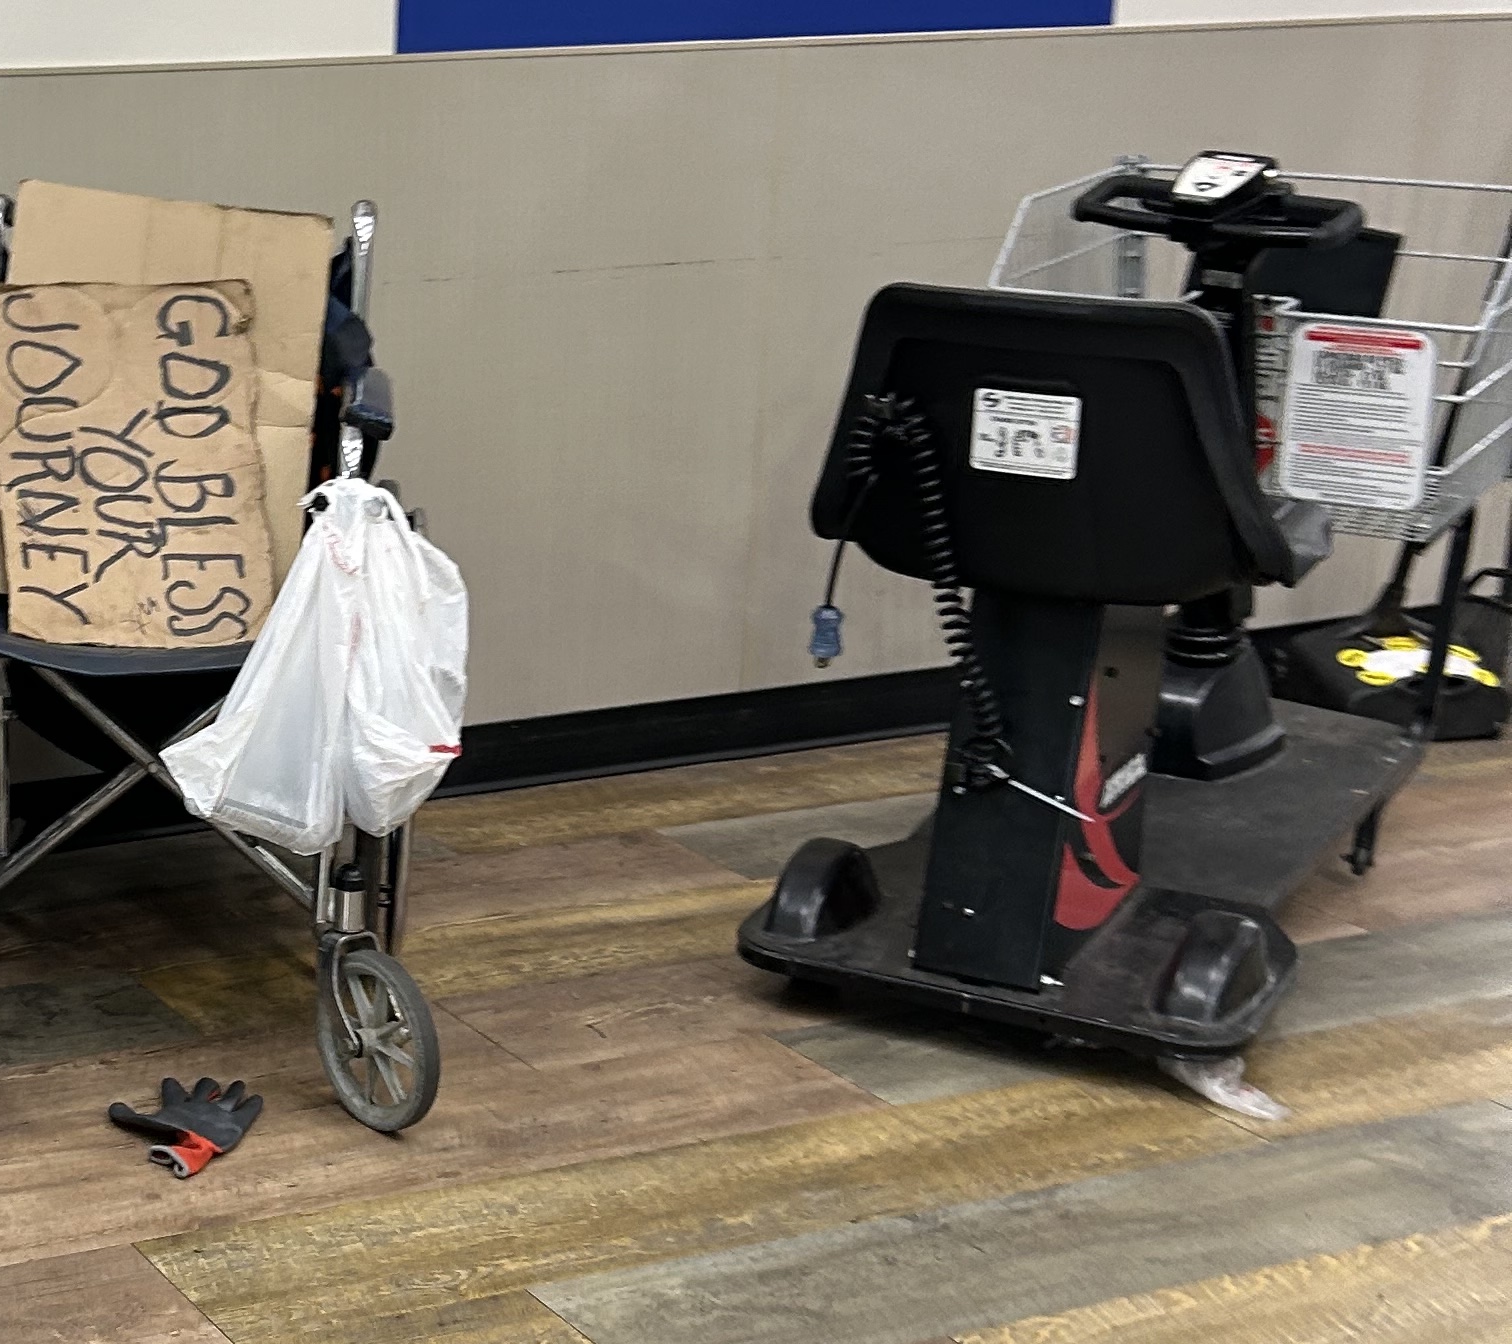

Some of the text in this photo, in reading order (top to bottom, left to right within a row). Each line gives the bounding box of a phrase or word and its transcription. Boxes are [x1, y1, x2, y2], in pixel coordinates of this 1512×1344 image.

[0, 292, 92, 625] JOURNEY
[77, 408, 167, 585] YOUR
[152, 294, 251, 640] GOD BLESS
